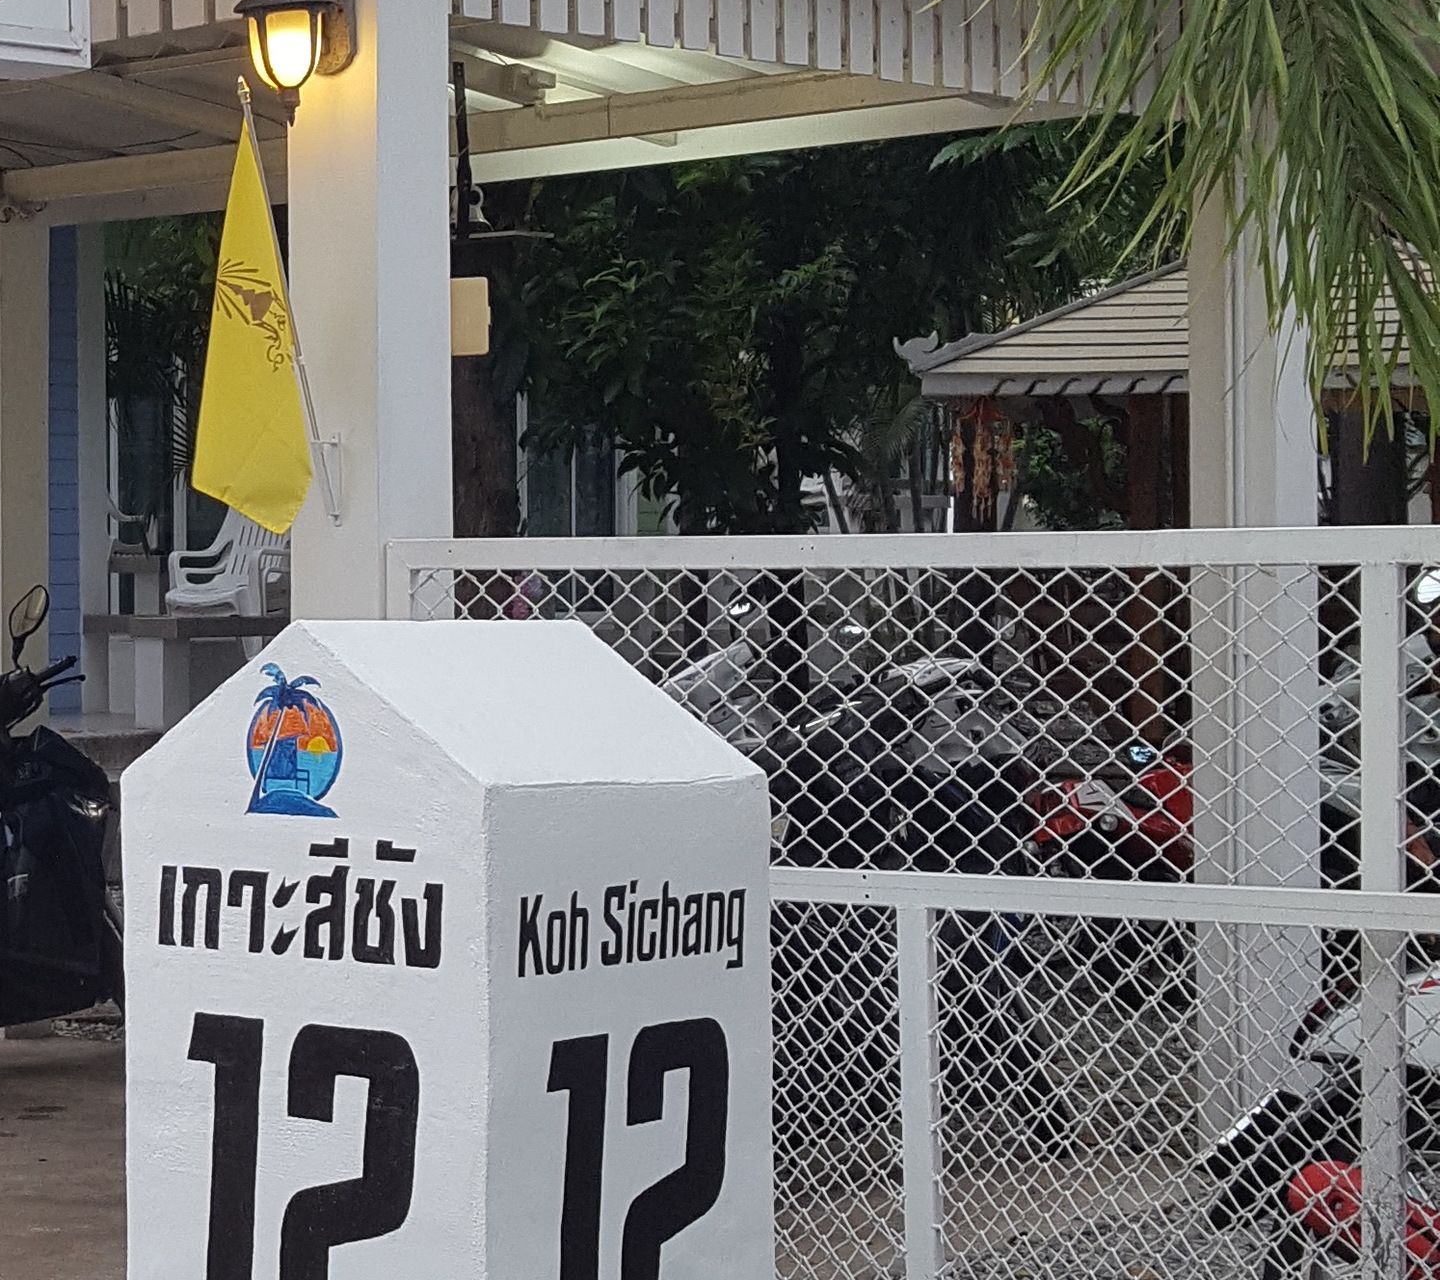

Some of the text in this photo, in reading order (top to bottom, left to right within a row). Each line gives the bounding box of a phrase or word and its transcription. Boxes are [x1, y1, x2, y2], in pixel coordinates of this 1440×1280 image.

[158, 837, 444, 969] เกาะสีชัง
[517, 879, 747, 978] Koh Sichang
